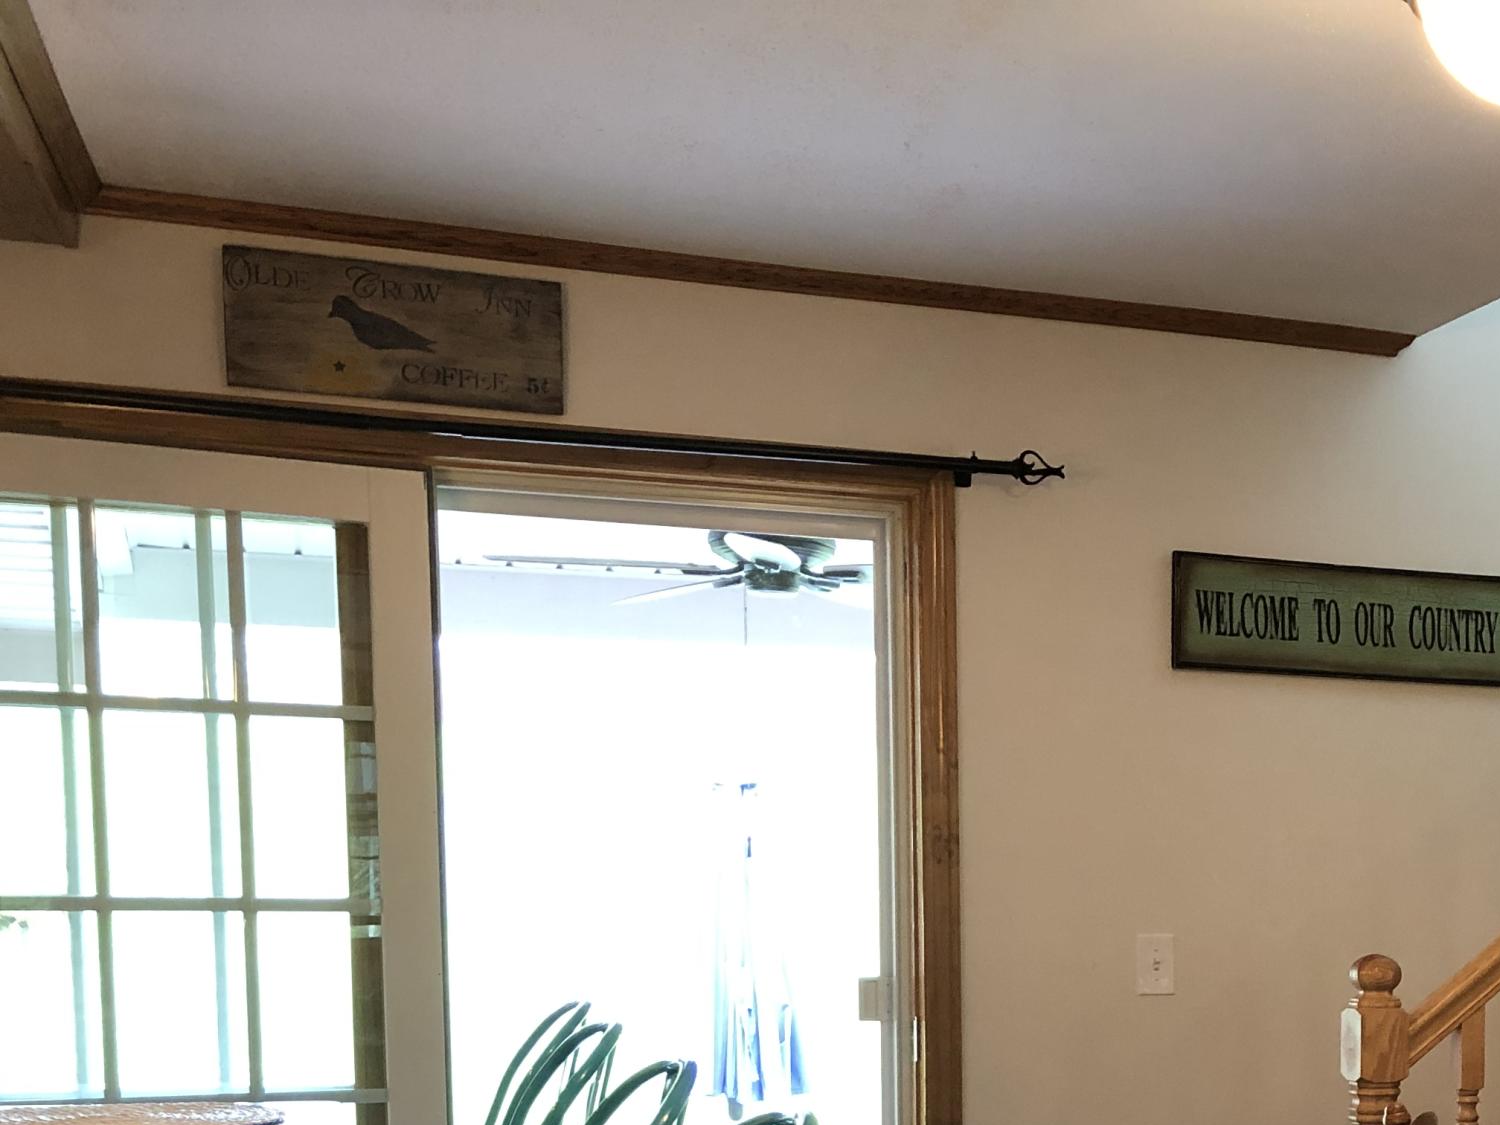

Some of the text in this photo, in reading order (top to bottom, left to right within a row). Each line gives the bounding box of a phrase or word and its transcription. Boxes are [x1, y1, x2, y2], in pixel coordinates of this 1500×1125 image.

[1195, 589, 1299, 641] WELCOME
[1313, 598, 1341, 645] TO
[1355, 602, 1397, 648] OUR
[1409, 605, 1499, 654] COUNTRY
